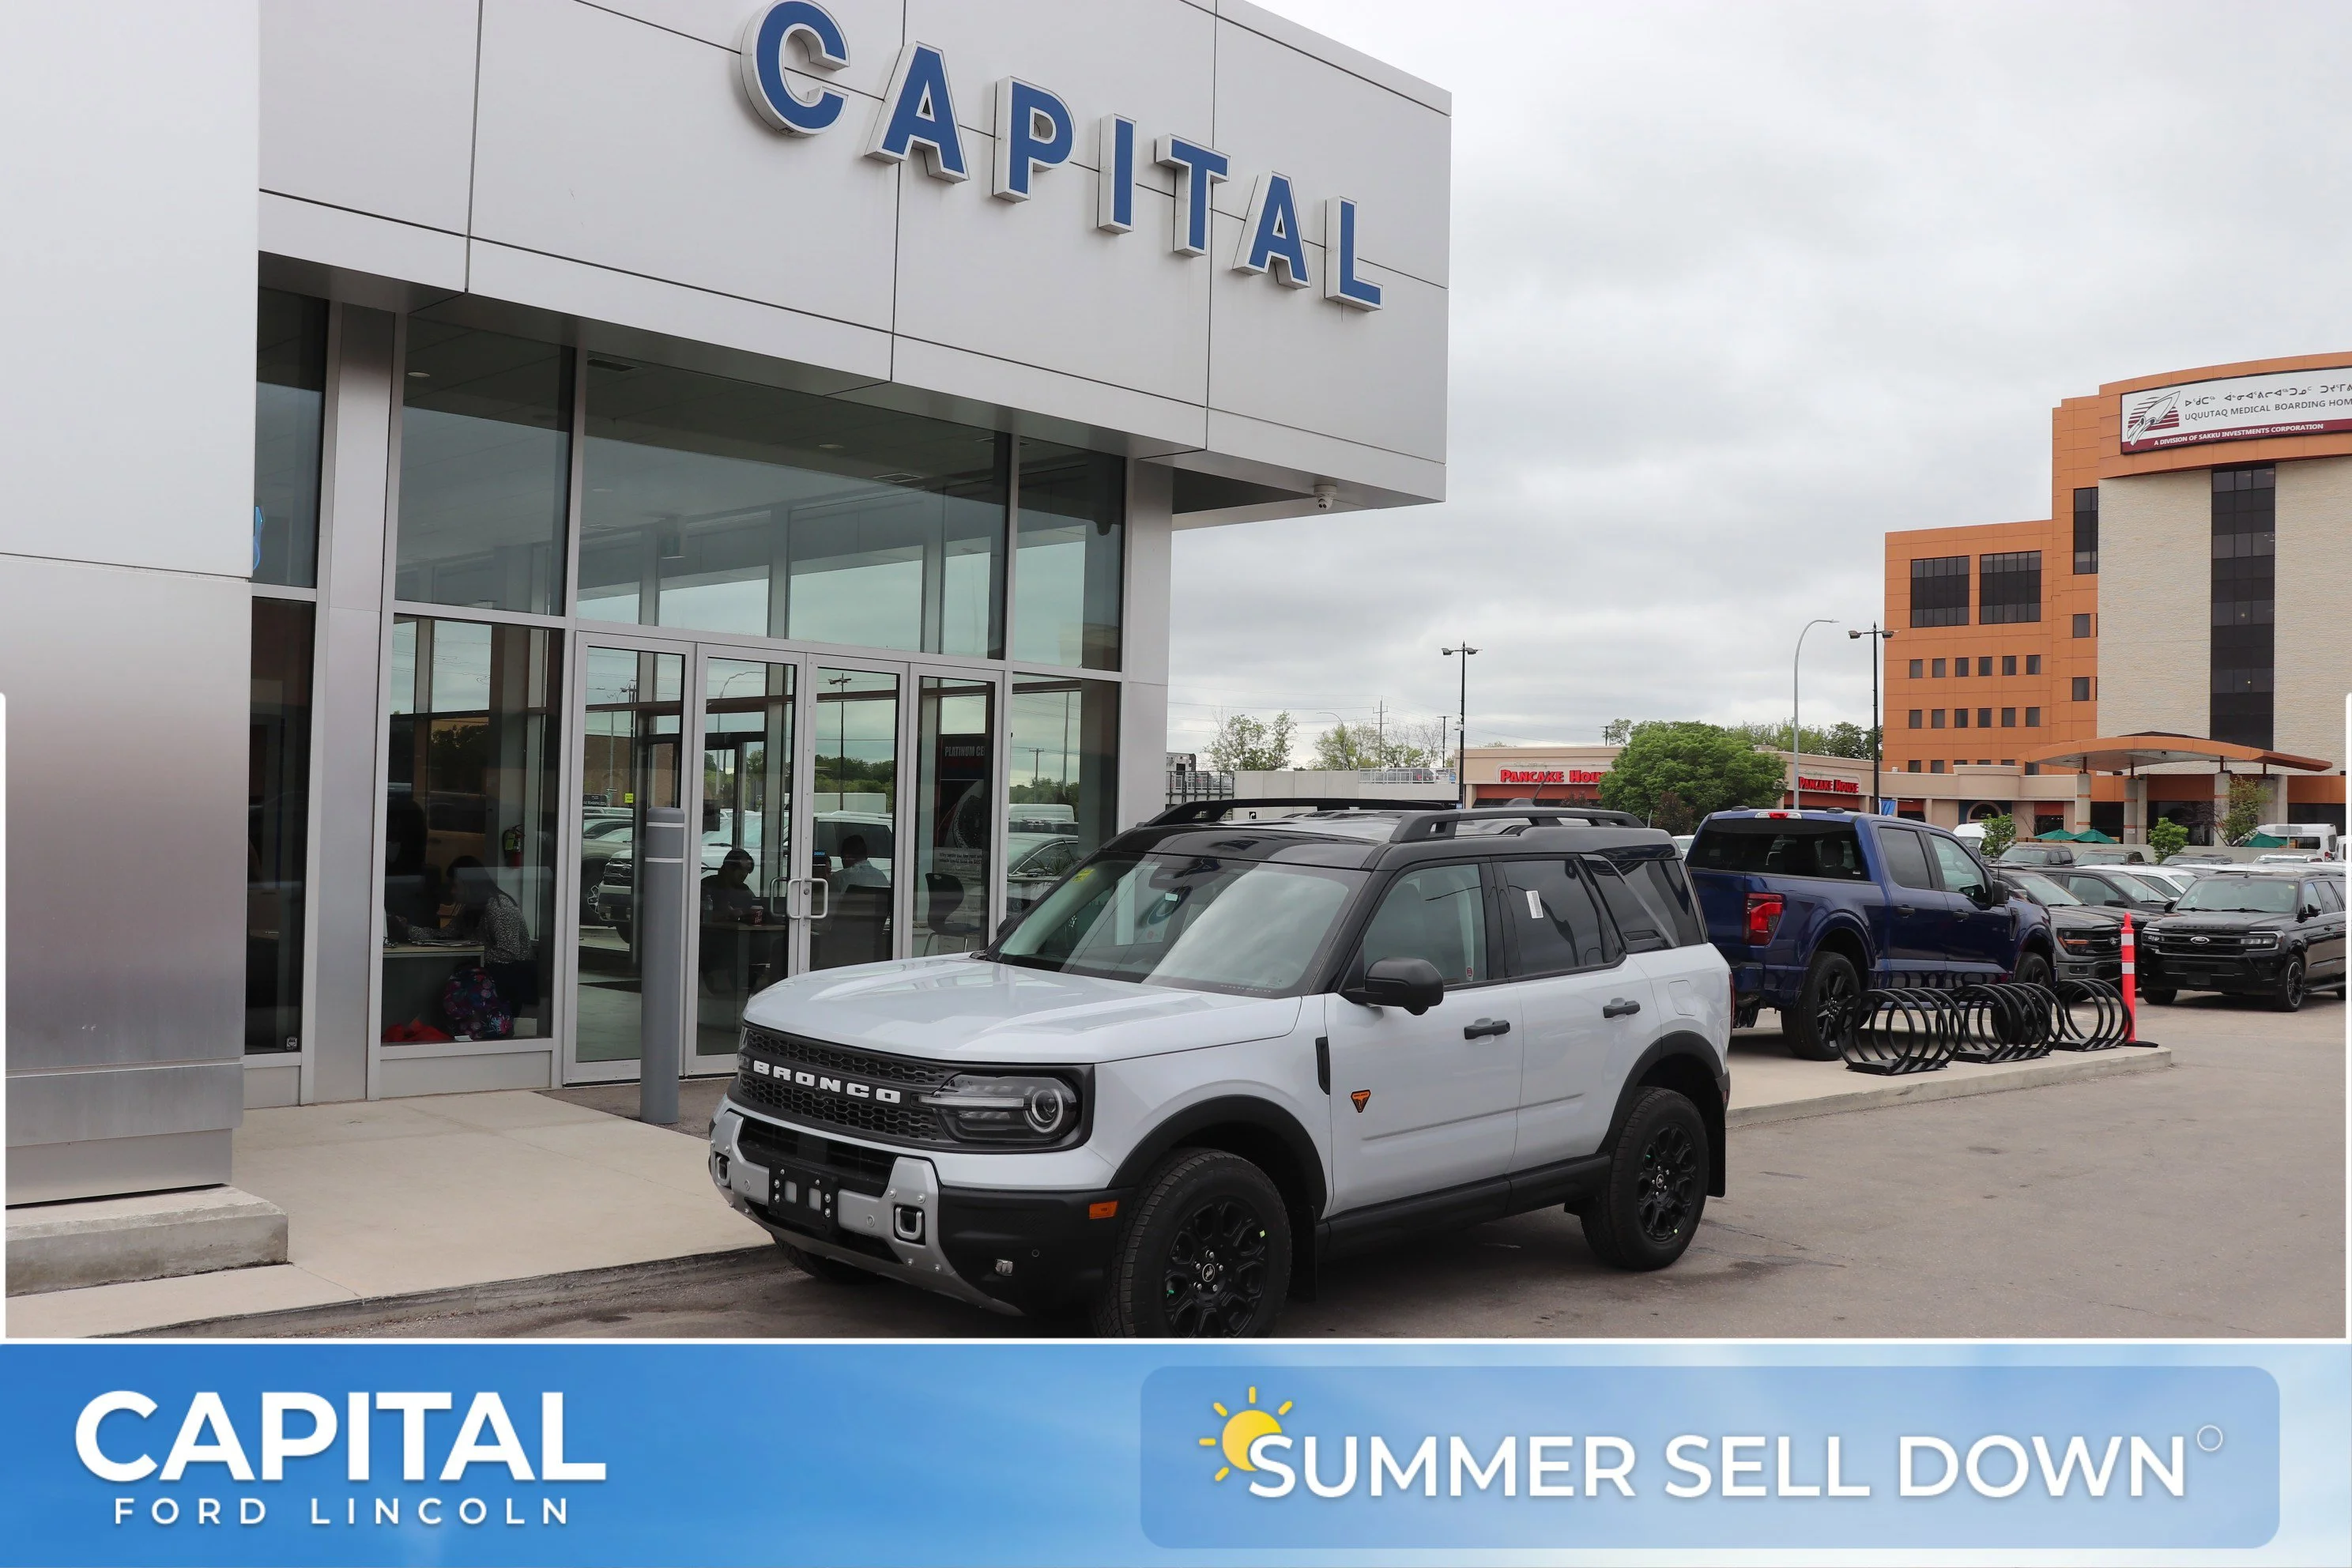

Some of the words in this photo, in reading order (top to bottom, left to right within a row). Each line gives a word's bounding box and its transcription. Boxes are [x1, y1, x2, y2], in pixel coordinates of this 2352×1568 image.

[741, 0, 1383, 312] CAPITAL
[2184, 409, 2228, 420] UQUUTAQ
[2230, 404, 2271, 415] MEDICAL
[2275, 400, 2325, 411] BOARDING
[2159, 436, 2187, 445] DIVISION
[2198, 432, 2220, 440] SAKKU
[2222, 428, 2269, 437] INVESTMENTS
[2271, 424, 2324, 432] CORPORATION
[944, 746, 975, 756] PLATINUM
[1500, 770, 1565, 782] PANCAKE
[1799, 777, 1833, 791] PANCAKE
[1834, 779, 1859, 793] HOUSE
[753, 1060, 901, 1103] BRONCO
